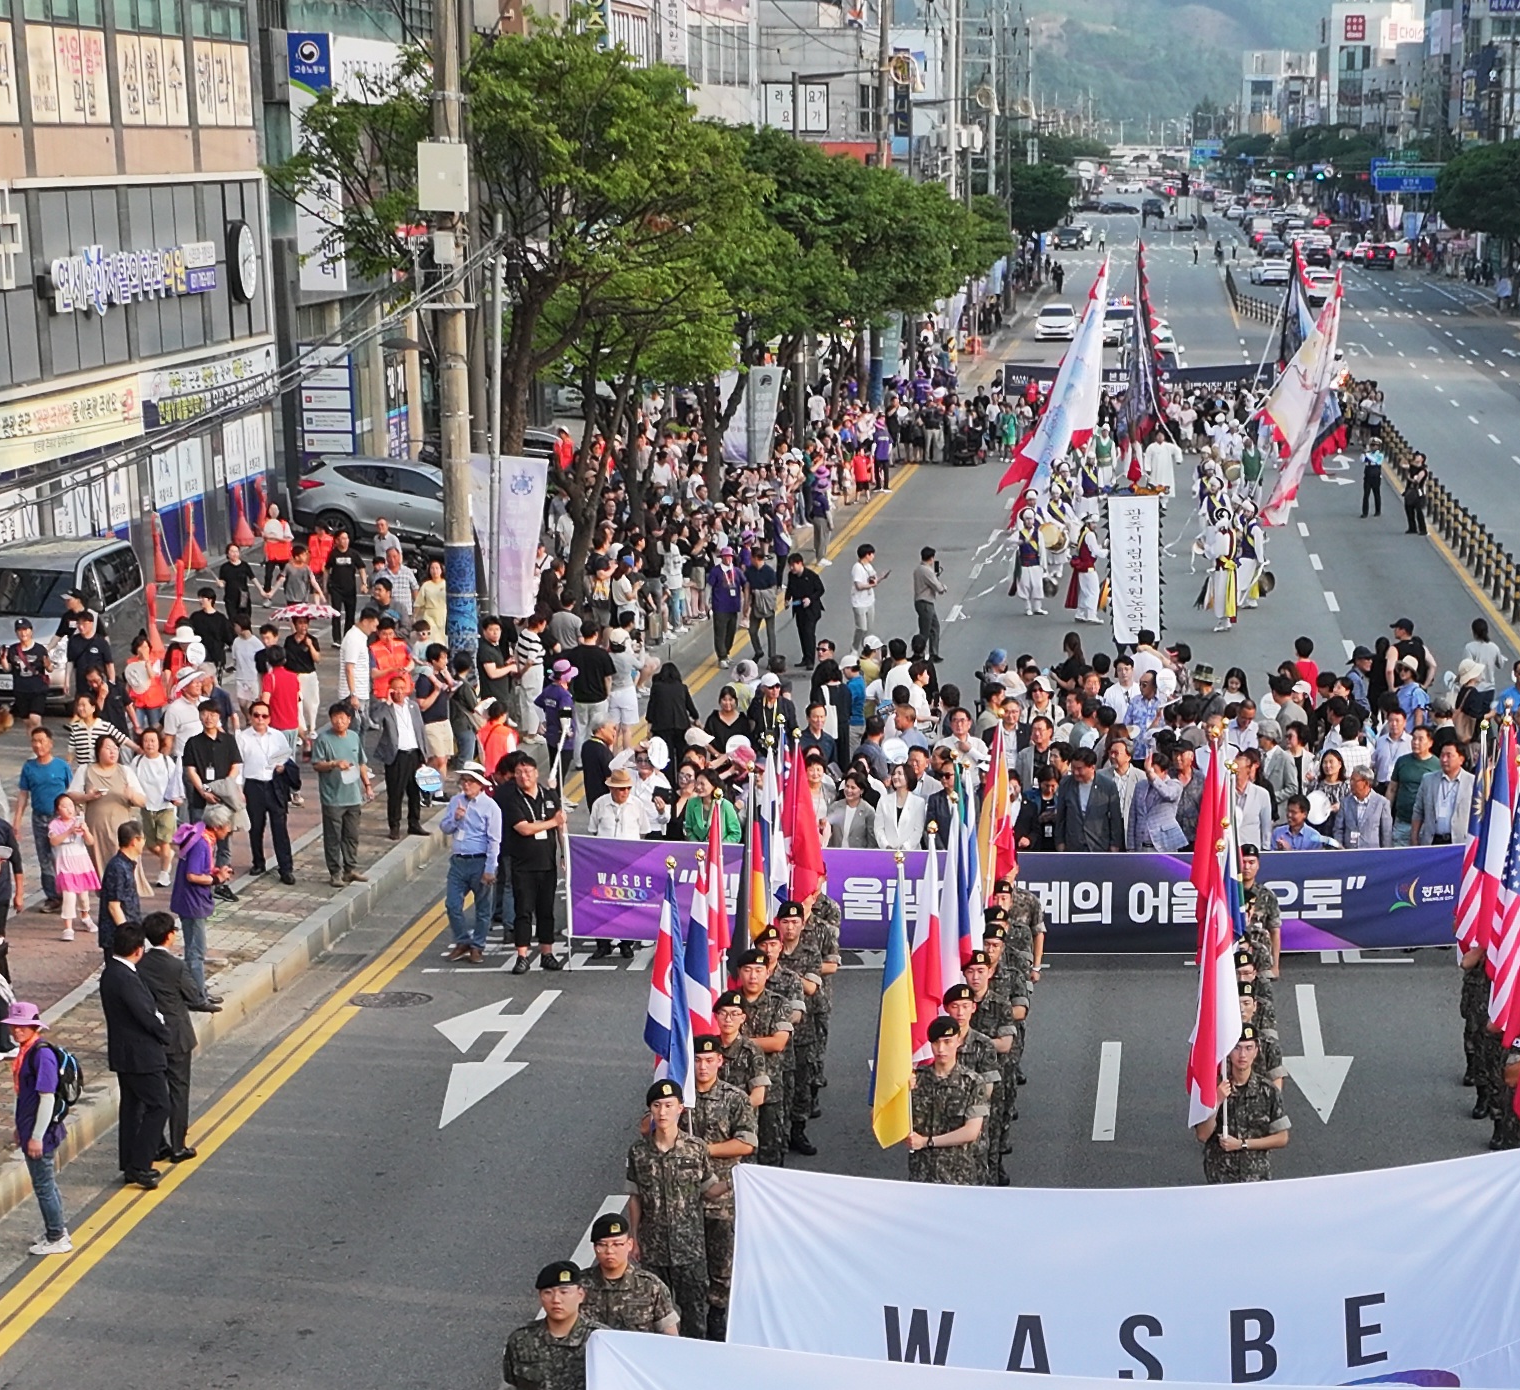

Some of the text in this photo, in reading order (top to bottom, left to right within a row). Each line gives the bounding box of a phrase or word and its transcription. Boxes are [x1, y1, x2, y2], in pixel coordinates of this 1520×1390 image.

[596, 872, 653, 889] WASBE
[1420, 884, 1455, 898] 광주시
[1013, 880, 1114, 925] 계의
[882, 1290, 1390, 1385] WASBE
